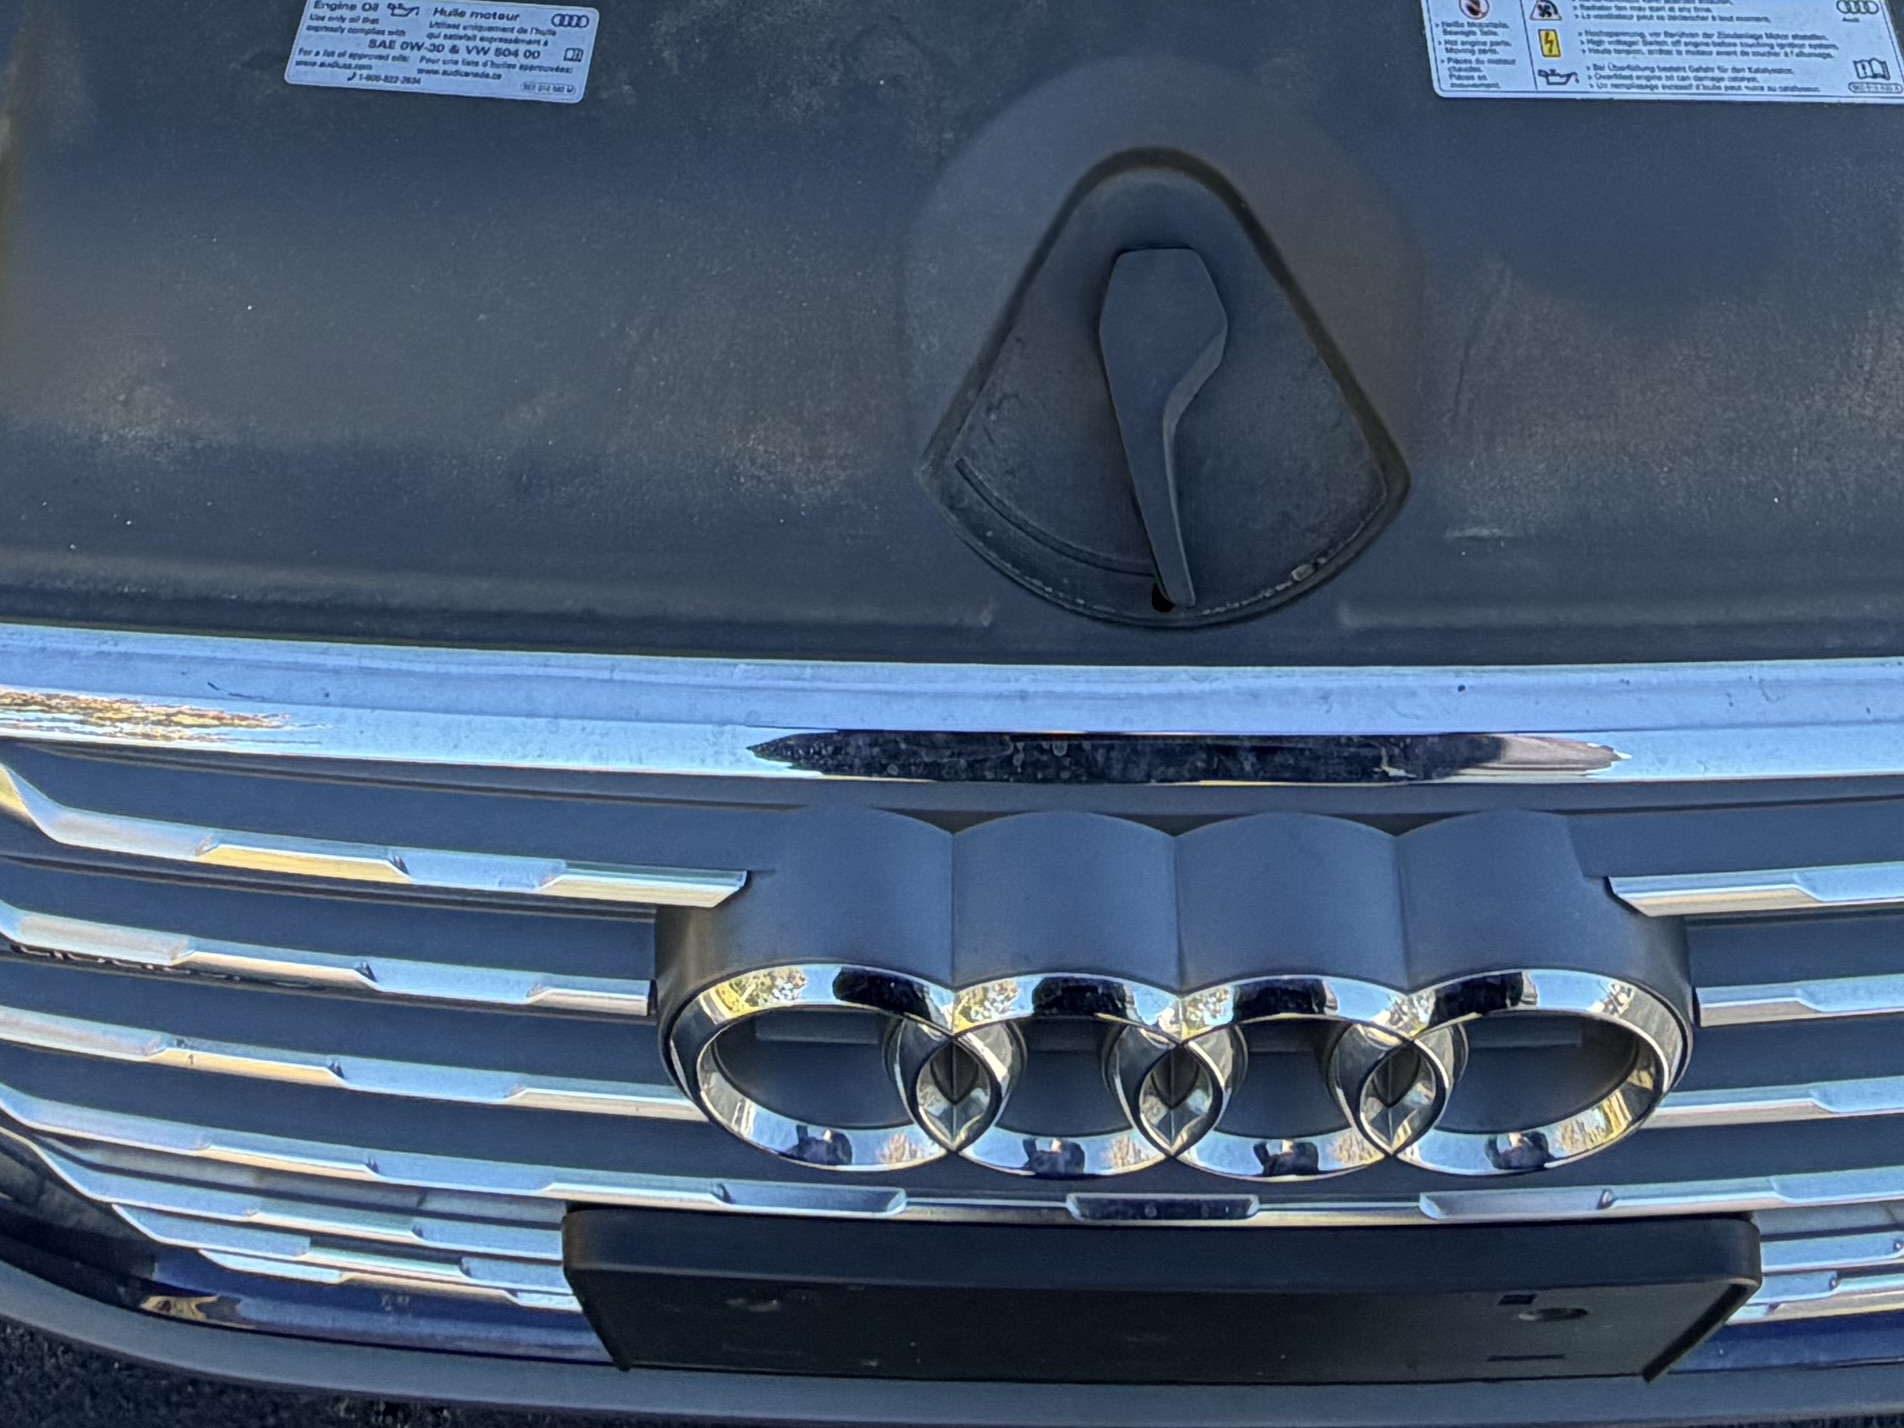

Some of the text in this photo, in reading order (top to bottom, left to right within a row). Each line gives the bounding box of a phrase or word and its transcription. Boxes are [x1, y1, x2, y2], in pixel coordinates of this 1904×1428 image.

[314, 0, 379, 12] Engine Oil
[433, 7, 520, 22] Huile moteur
[368, 39, 540, 59] SAE 0W-30 & VW 504 00
